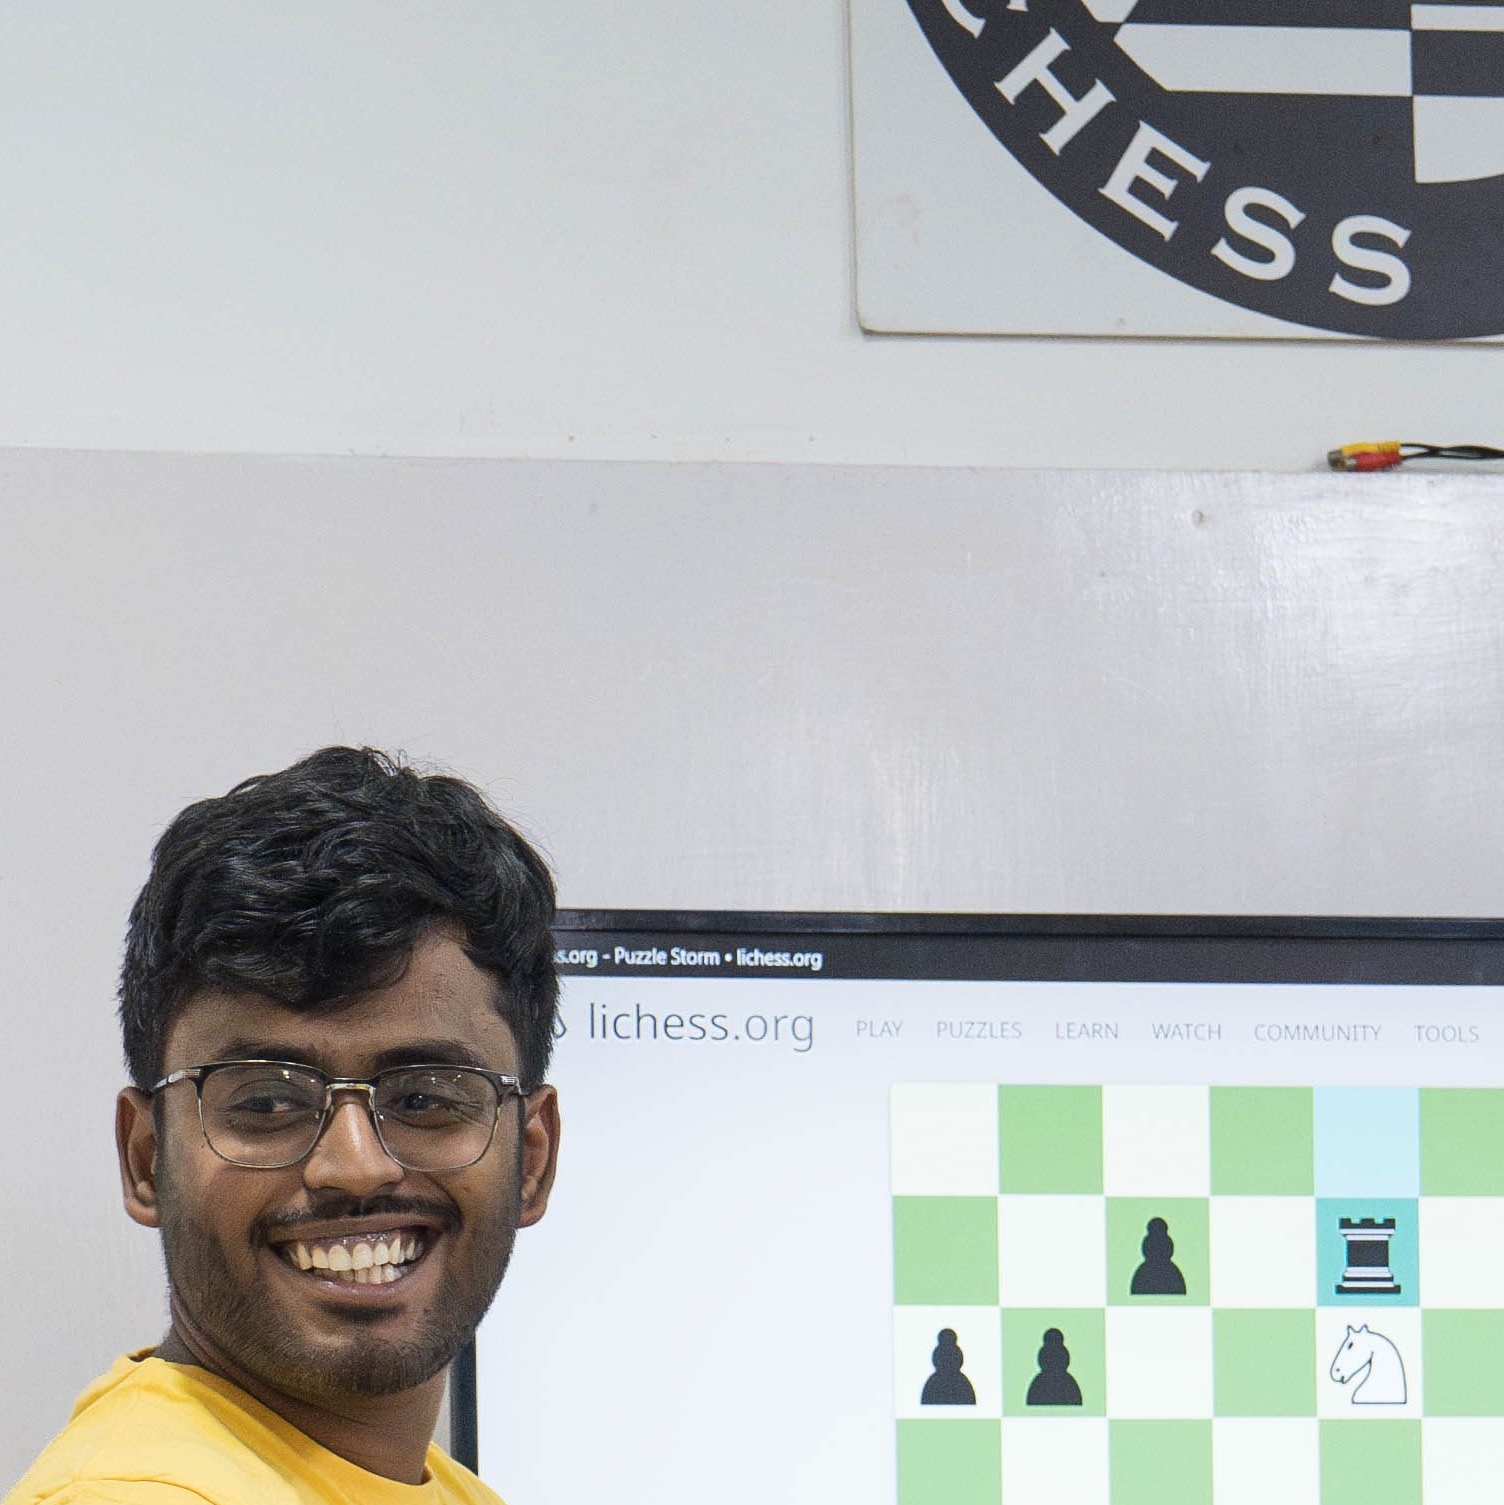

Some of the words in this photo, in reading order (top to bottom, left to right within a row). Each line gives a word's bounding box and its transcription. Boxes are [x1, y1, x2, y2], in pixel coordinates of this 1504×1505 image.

[613, 946, 667, 966] Puzzle
[671, 946, 721, 966] Storm
[736, 948, 823, 971] lichess.org
[589, 1002, 813, 1053] lichess.org
[856, 1019, 903, 1038] PLAY
[936, 1020, 1023, 1040] PUZZLES
[1055, 1021, 1119, 1040] LEARN
[1151, 1022, 1222, 1041] WATCH
[1253, 1023, 1382, 1042] COMMUNITY
[1413, 1024, 1480, 1043] TOOLS
